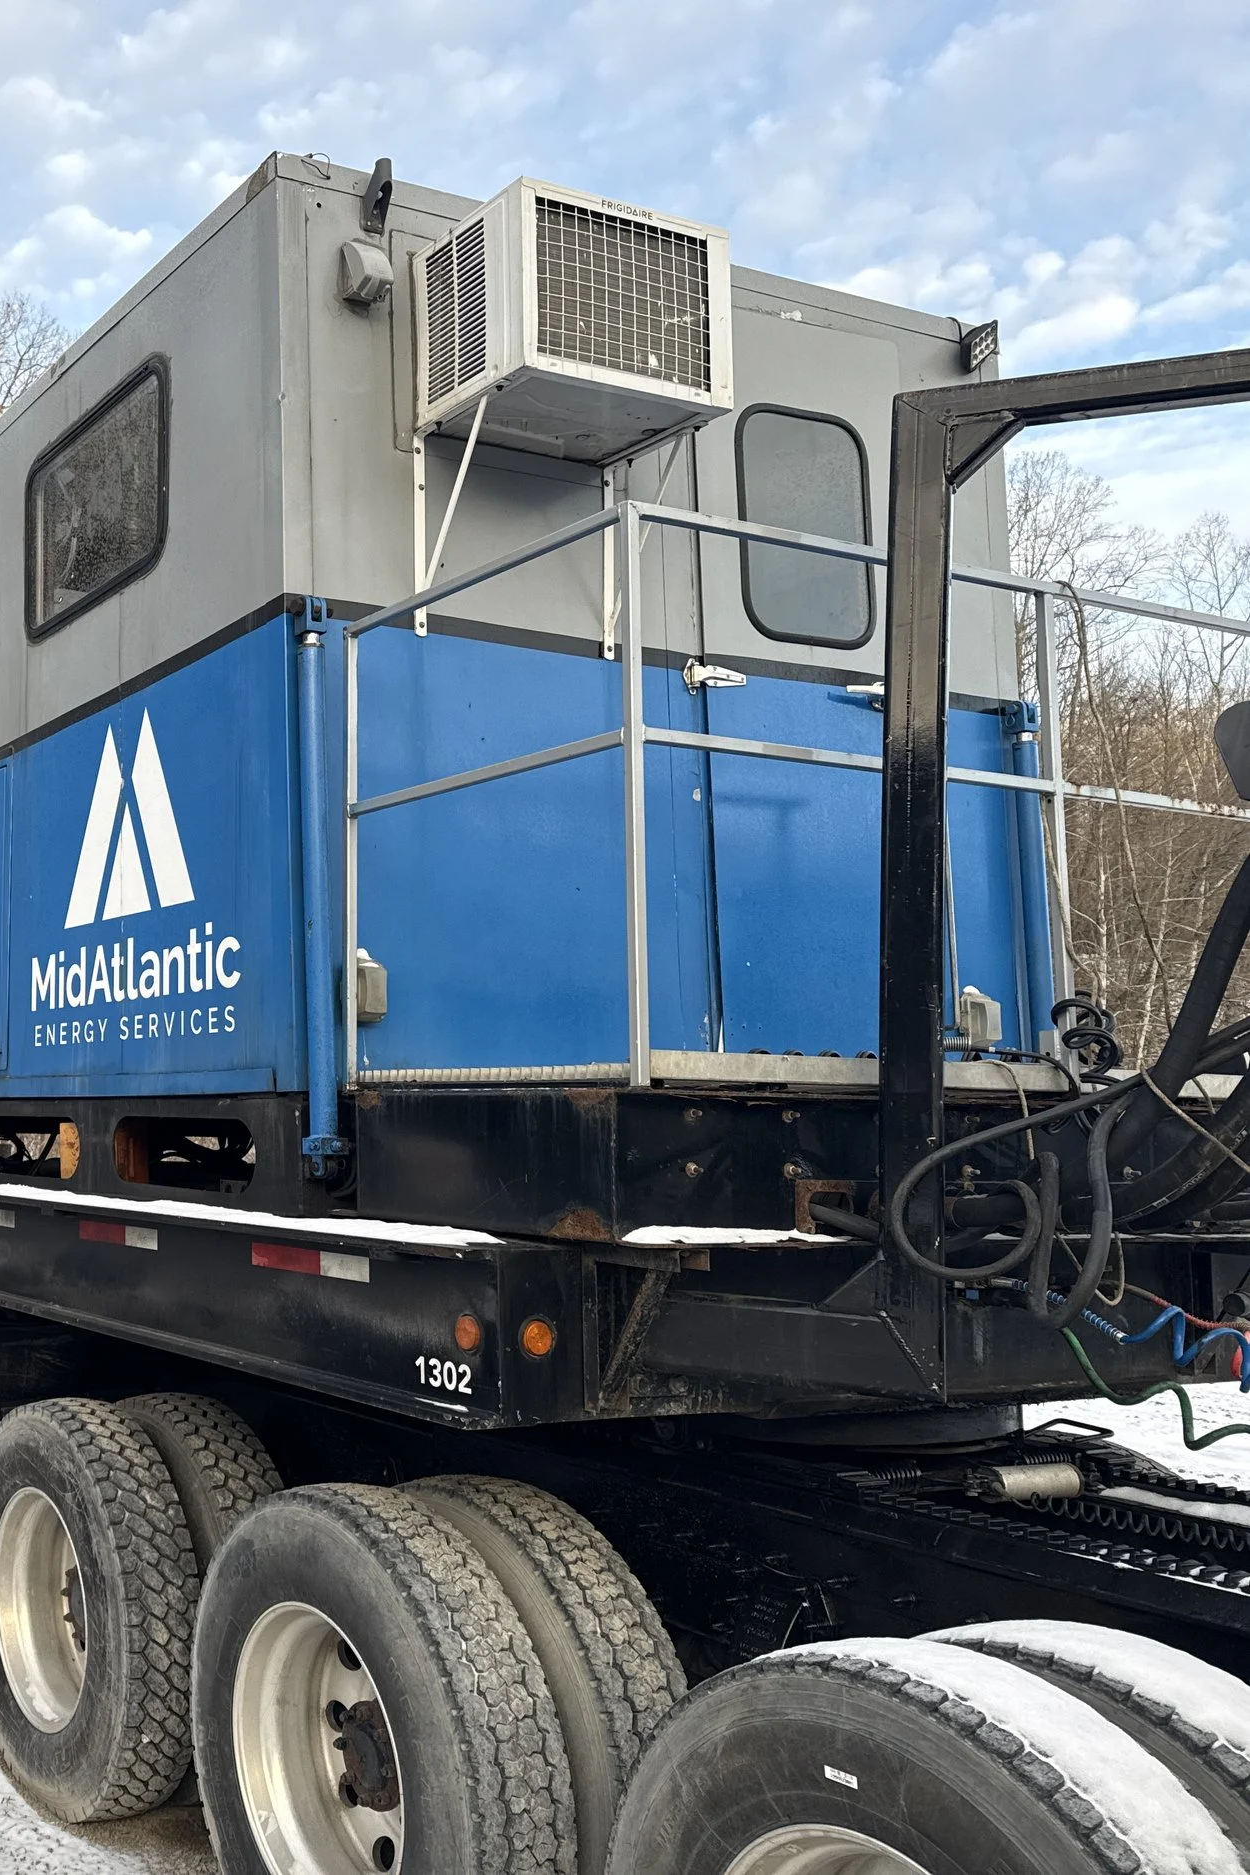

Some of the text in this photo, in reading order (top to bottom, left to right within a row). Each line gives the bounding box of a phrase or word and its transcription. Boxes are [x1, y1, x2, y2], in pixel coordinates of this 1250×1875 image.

[601, 199, 654, 221] FRIGIDAIRE
[31, 921, 242, 1012] MidAtlantic
[34, 1005, 236, 1047] ENERGY SERVICES
[415, 1355, 472, 1395] 1302
